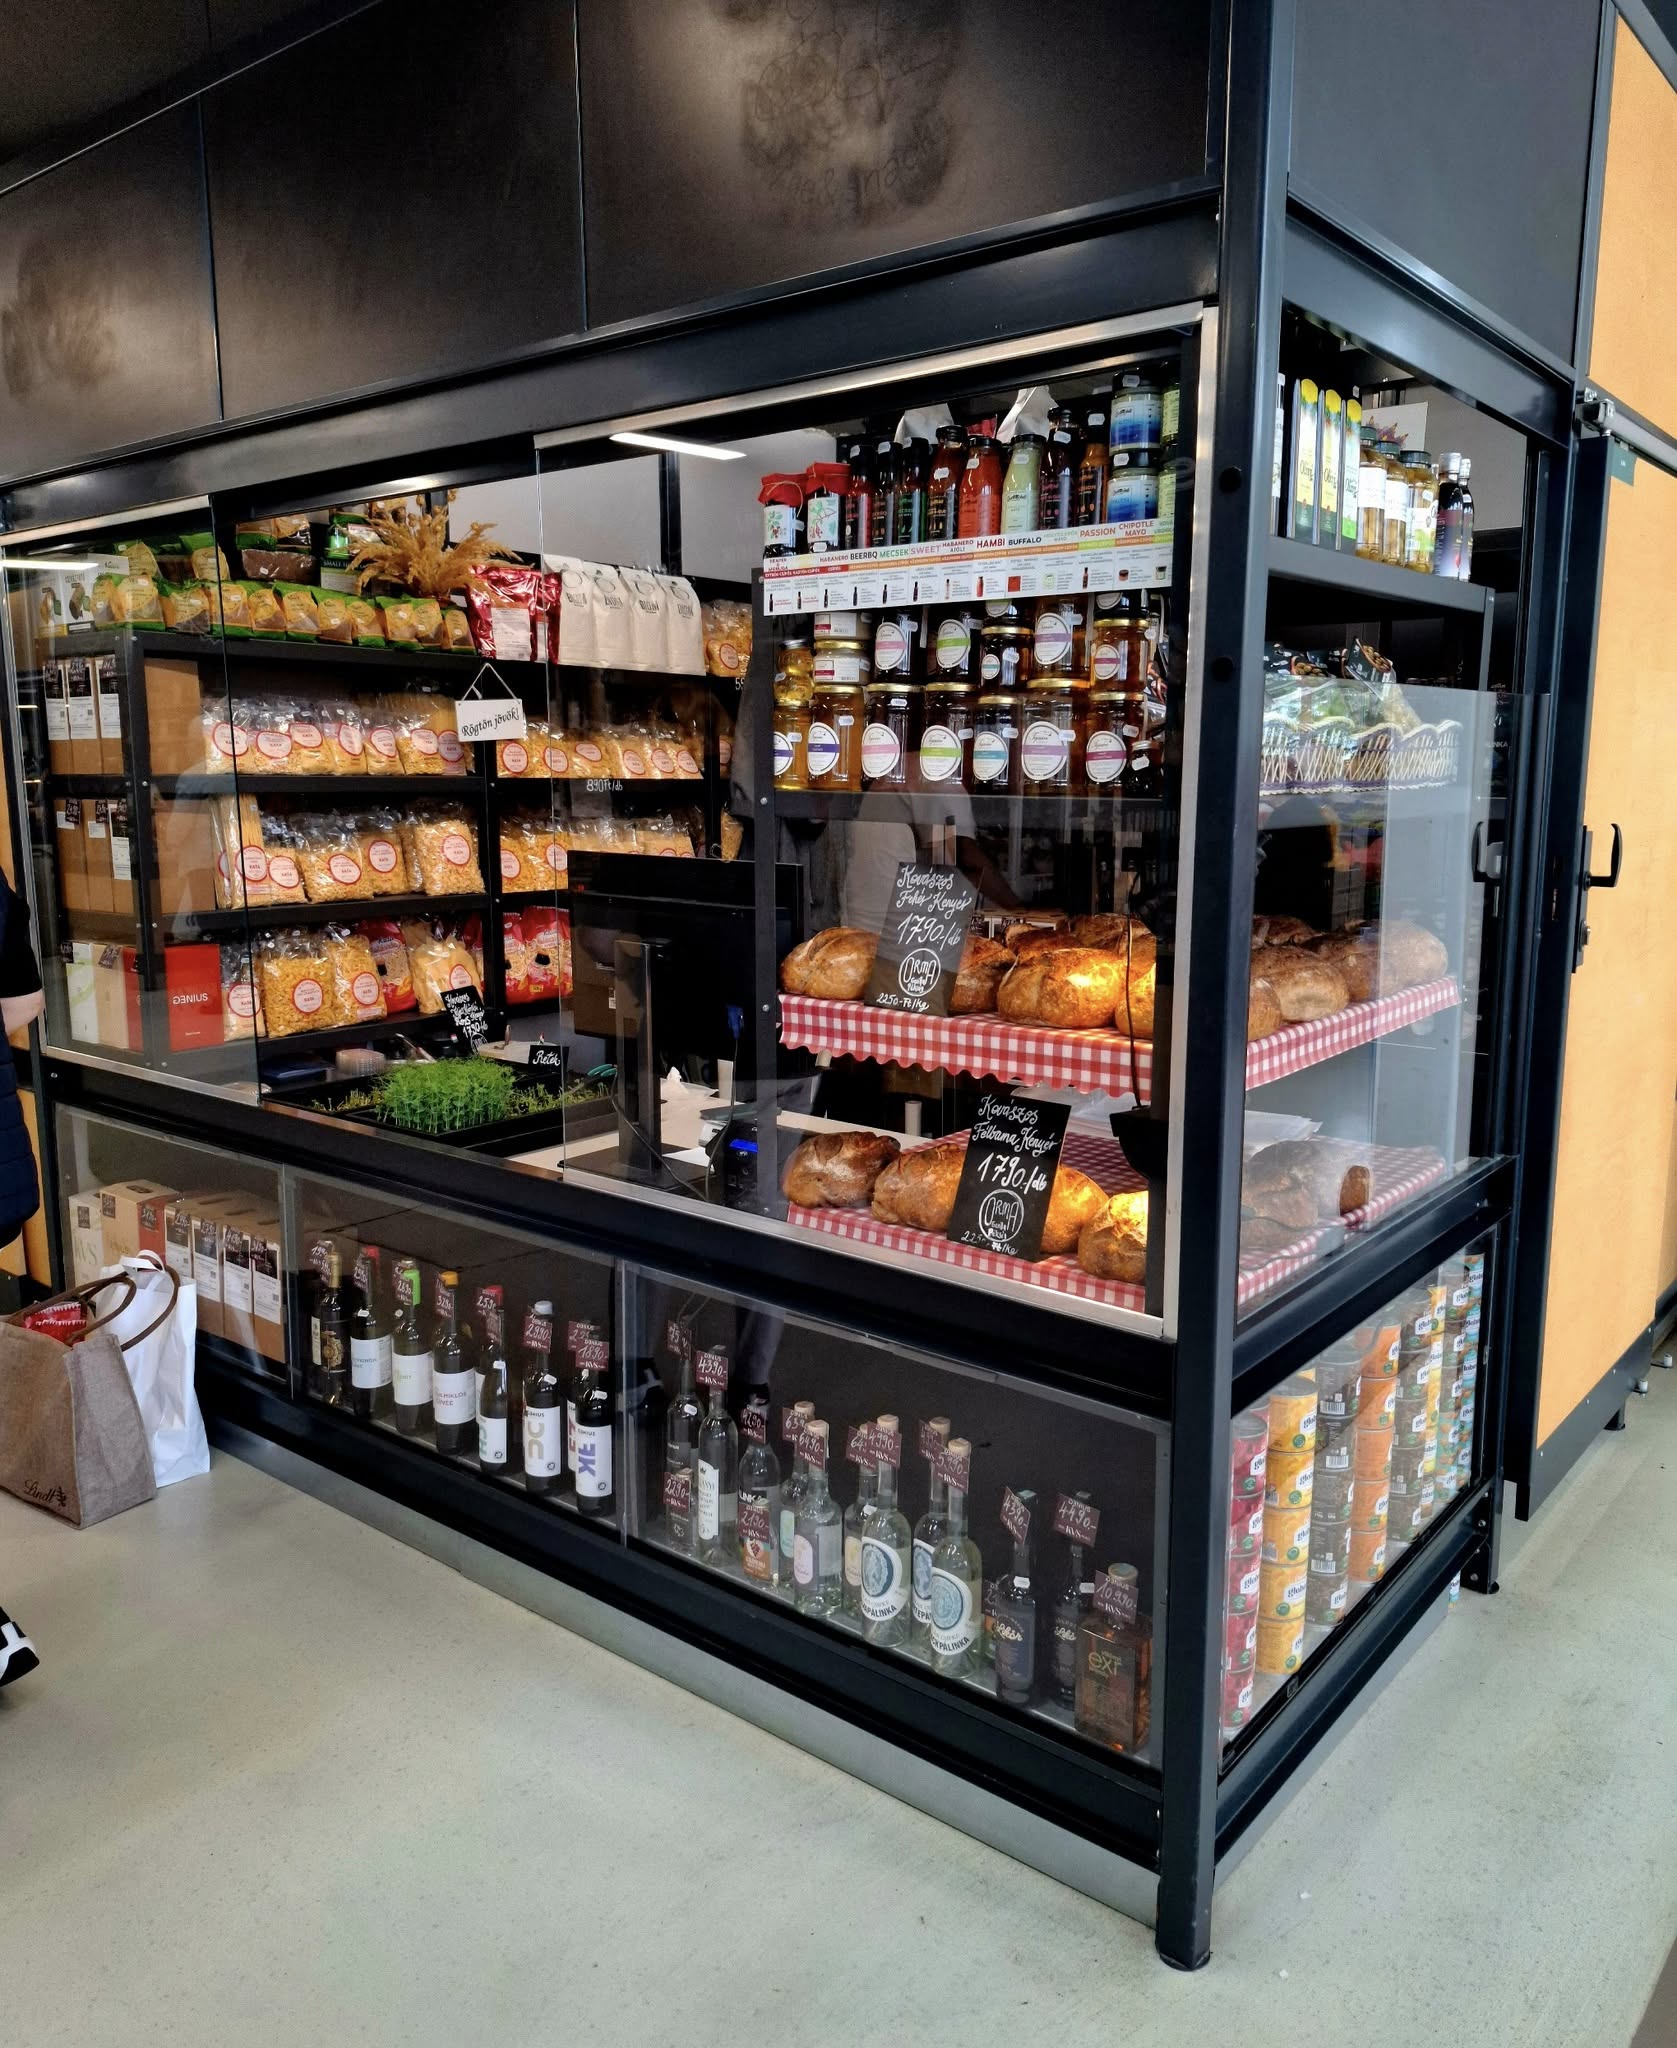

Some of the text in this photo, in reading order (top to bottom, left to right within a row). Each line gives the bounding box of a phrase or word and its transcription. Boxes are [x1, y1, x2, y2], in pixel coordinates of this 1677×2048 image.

[1118, 520, 1154, 531] CHIPOTLE
[1080, 527, 1117, 538] PASSION
[1124, 528, 1148, 538] MAYO
[942, 539, 975, 549] HABANERO
[976, 537, 1006, 549] HAMBI
[1008, 536, 1043, 546] BUFFALO
[880, 548, 909, 559] MECSEK
[910, 544, 942, 555] SWEET
[850, 550, 878, 561] BEERBQ
[978, 1094, 1039, 1125] Kovászos
